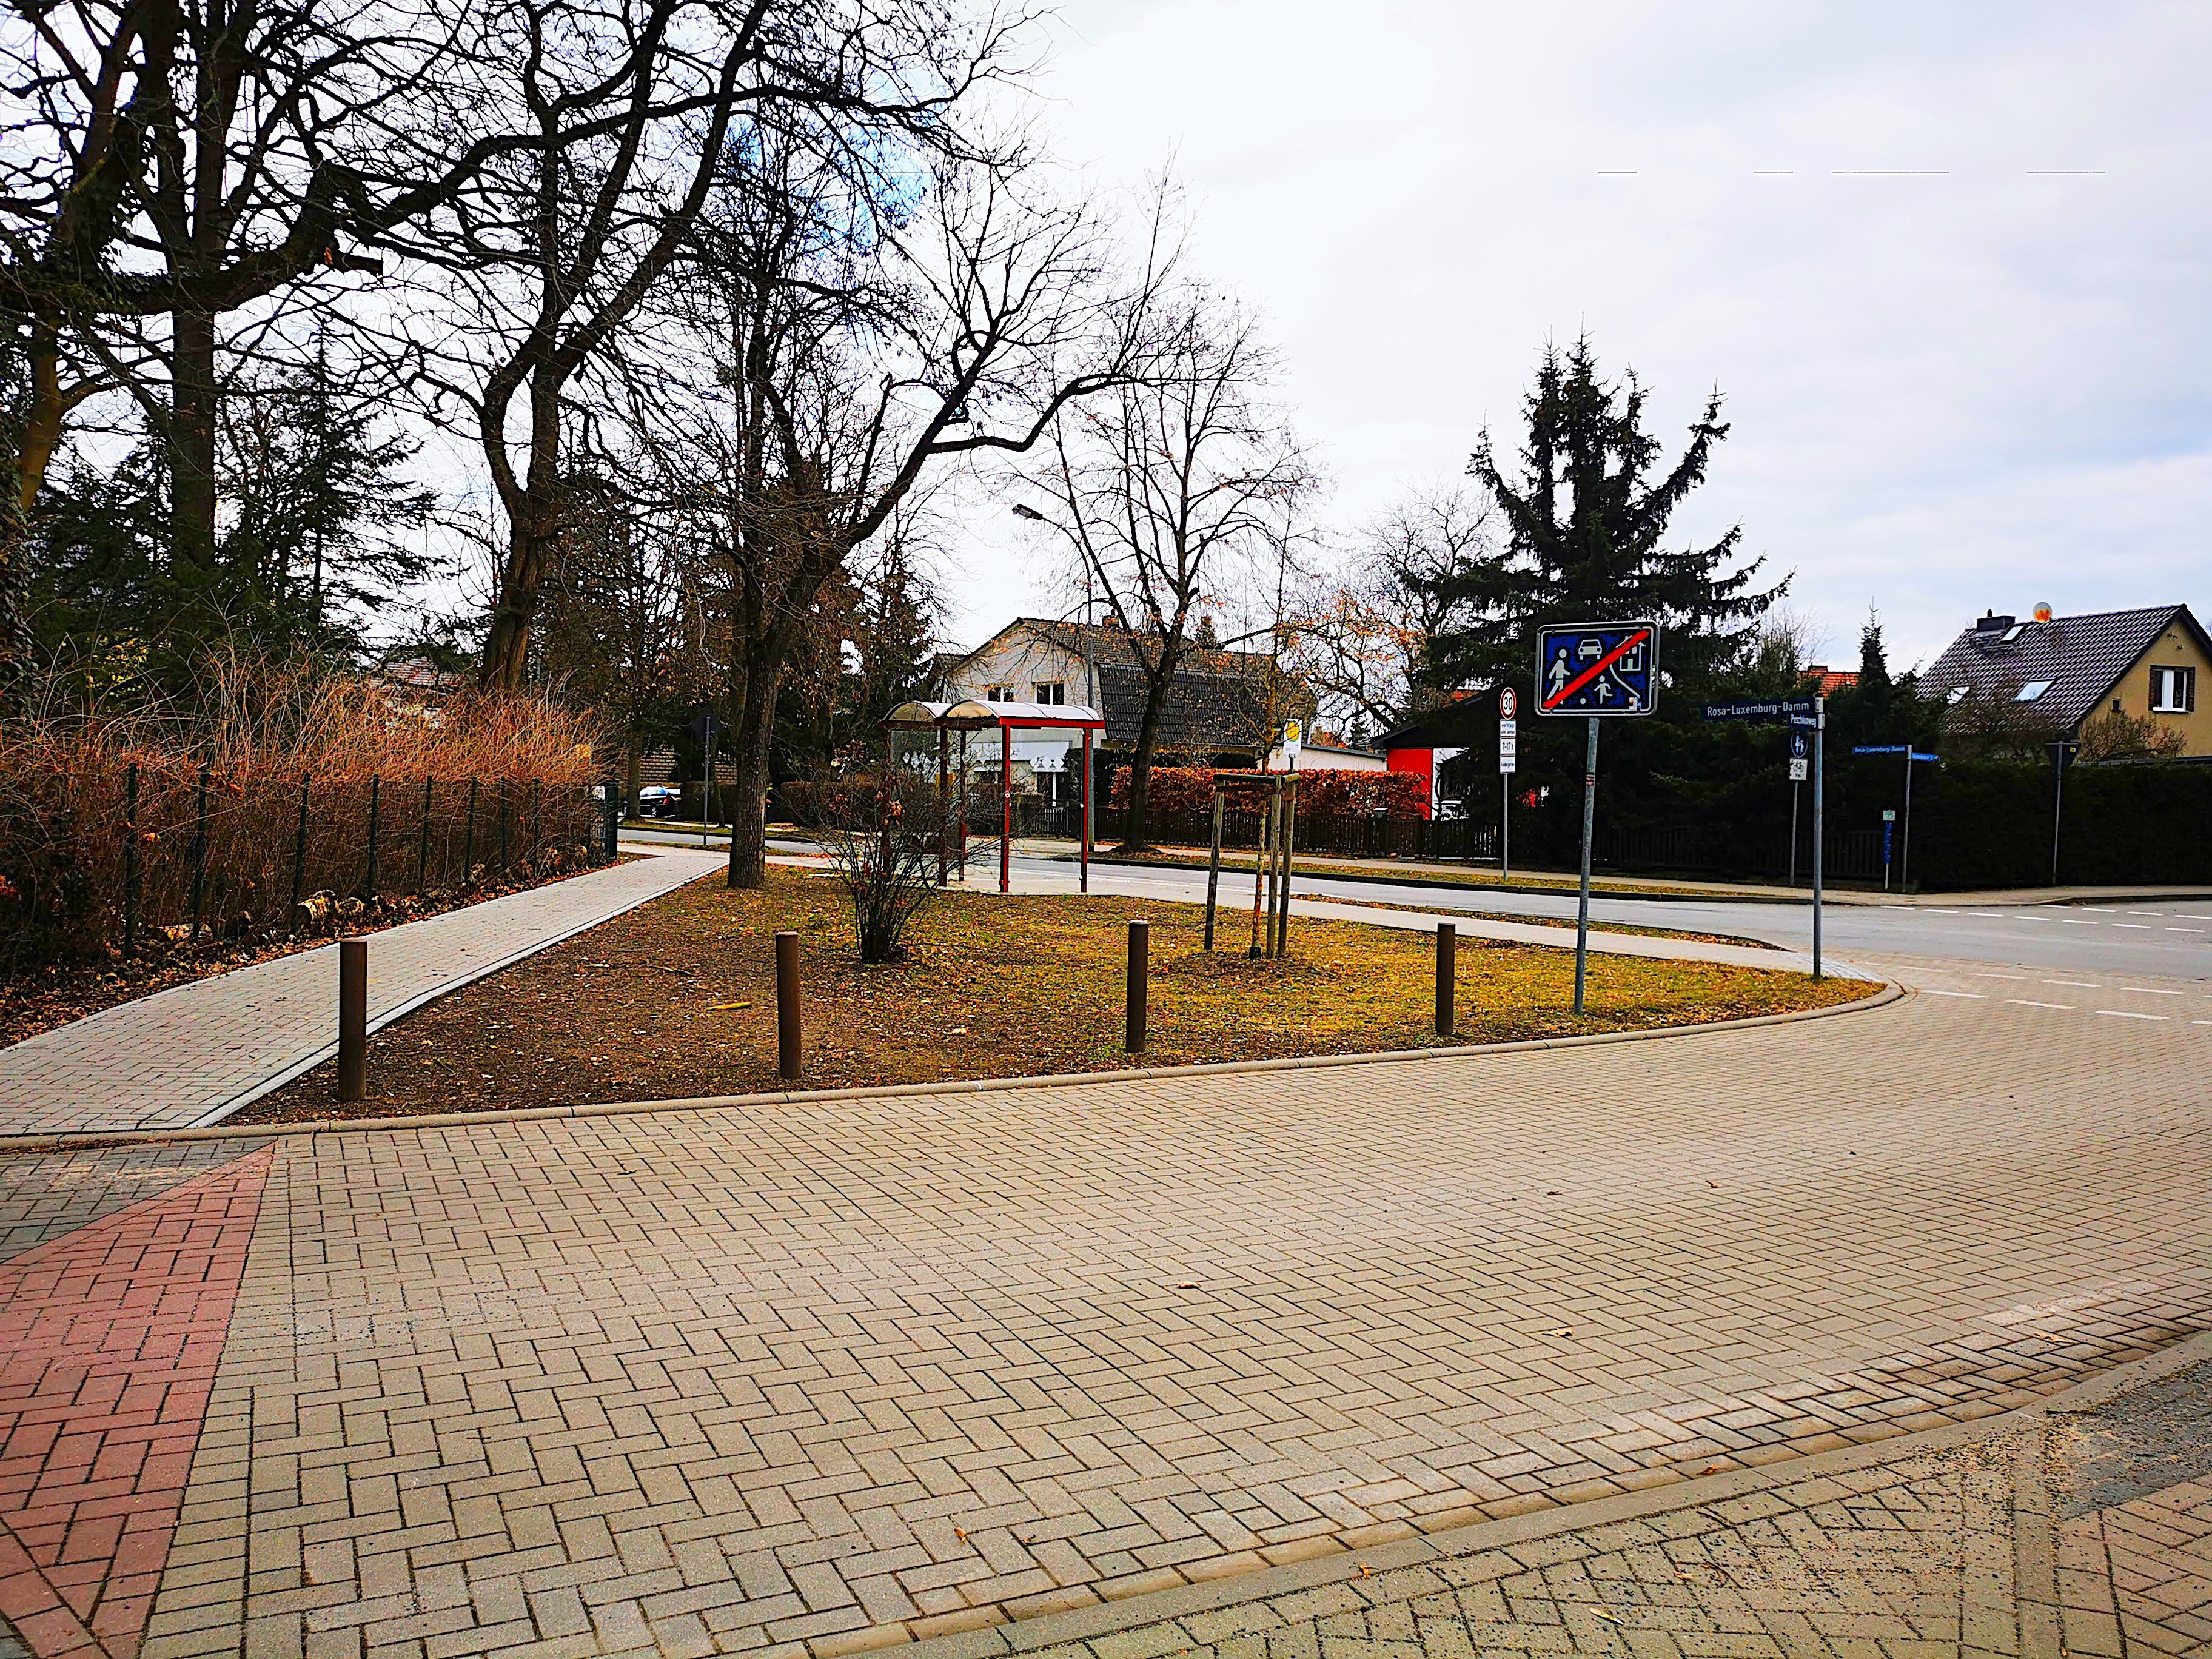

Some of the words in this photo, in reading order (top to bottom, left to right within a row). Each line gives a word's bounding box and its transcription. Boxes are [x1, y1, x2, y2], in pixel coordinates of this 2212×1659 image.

[1504, 697, 1513, 711] 30
[1707, 701, 1809, 717] Rosa-Luxemburg-Damm
[1502, 742, 1511, 751] 7-17
